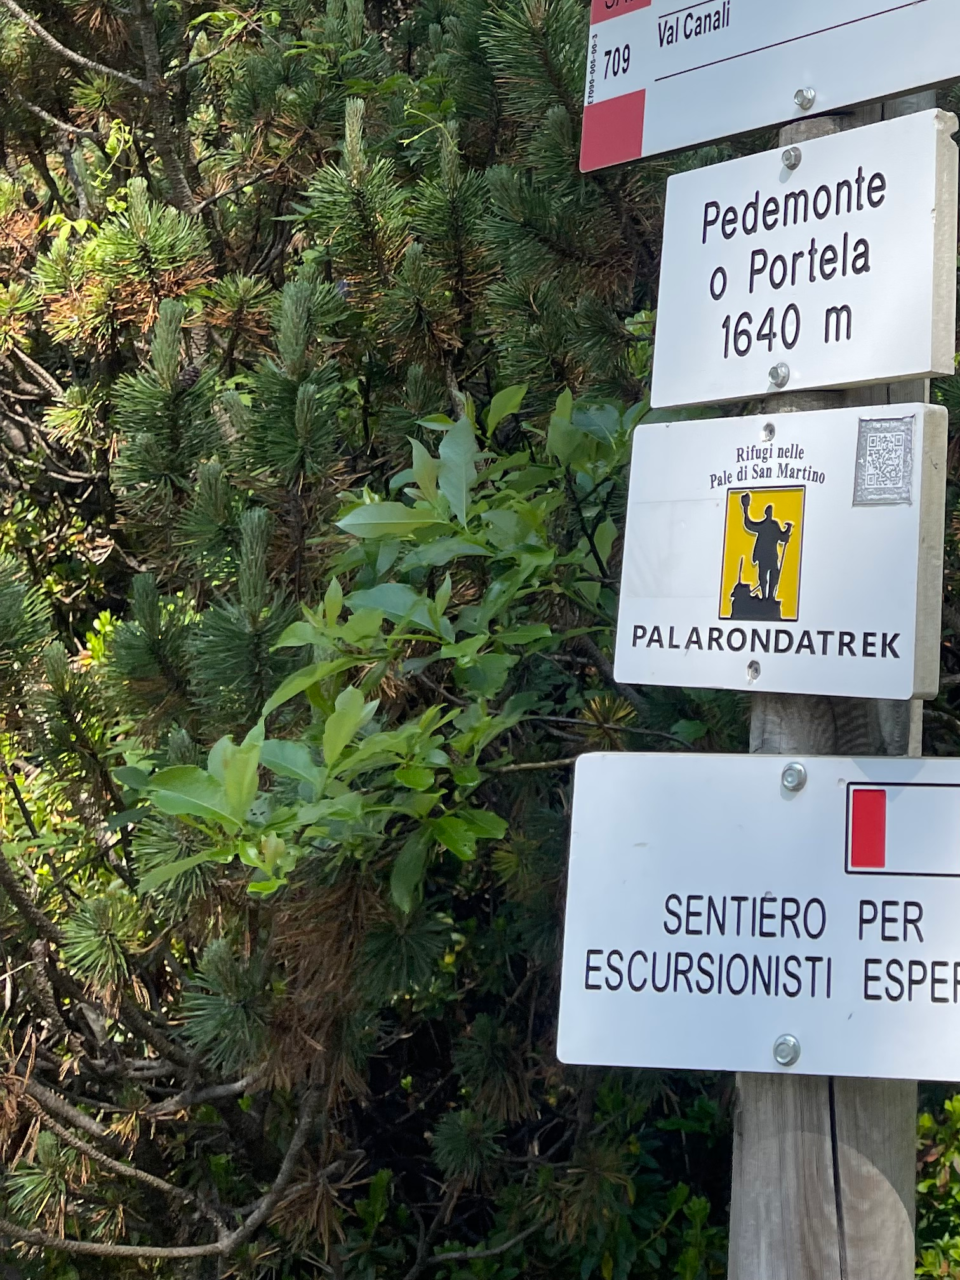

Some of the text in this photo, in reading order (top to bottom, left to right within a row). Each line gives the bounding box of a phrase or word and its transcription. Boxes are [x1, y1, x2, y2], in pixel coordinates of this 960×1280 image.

[658, 0, 730, 48] Val Canali
[604, 44, 631, 80] 709
[702, 166, 886, 244] Pedemonte
[710, 232, 870, 300] o Portela
[722, 303, 851, 358] 1640 m
[710, 462, 826, 489] Pale di San Martino
[736, 443, 804, 463] Rifugi nelle
[632, 624, 901, 658] PALARONDATREK
[663, 893, 924, 943] SENTIERO PER
[584, 949, 832, 999] ESCURSIONISTI
